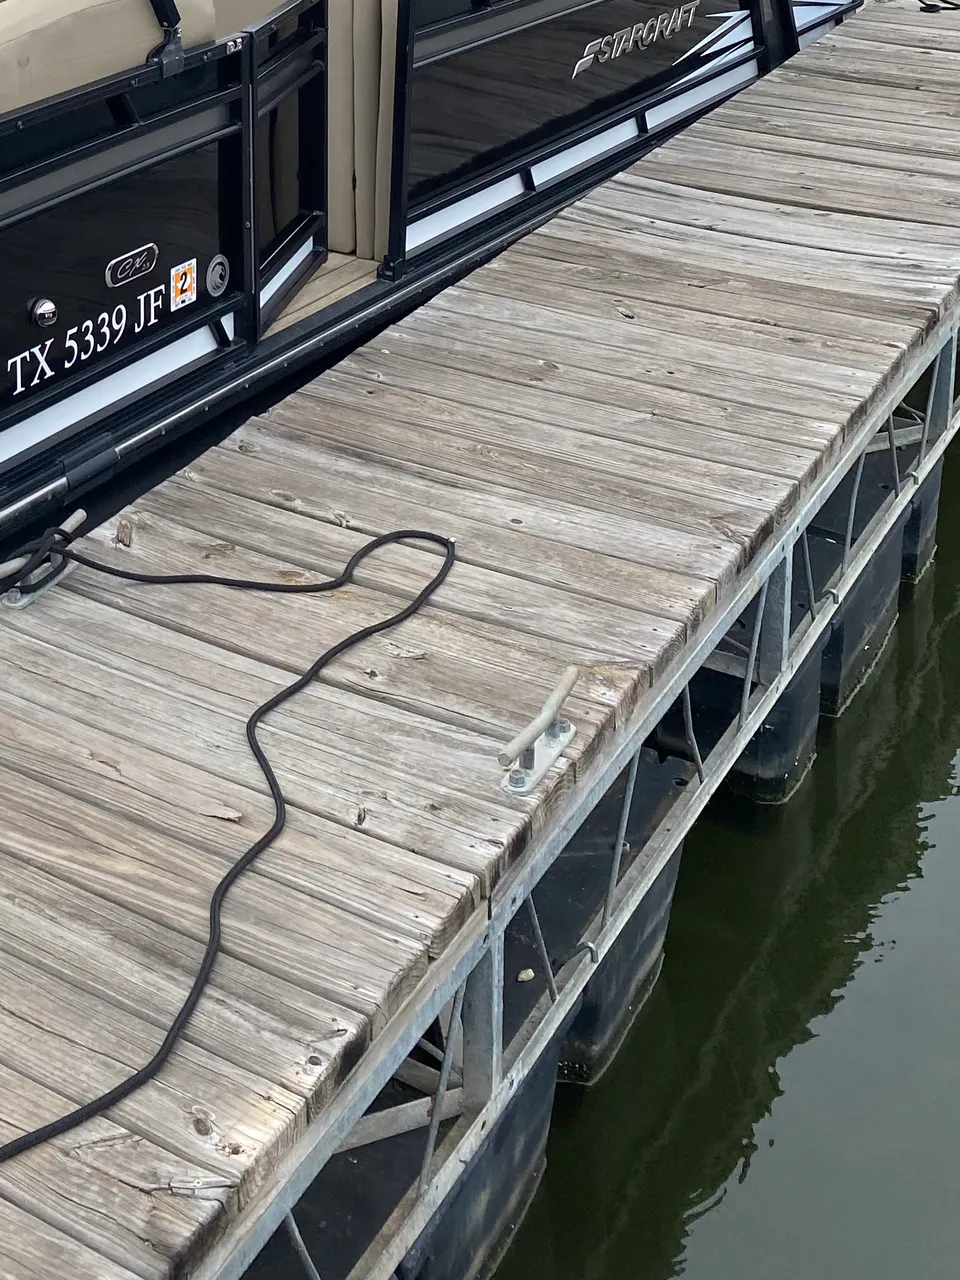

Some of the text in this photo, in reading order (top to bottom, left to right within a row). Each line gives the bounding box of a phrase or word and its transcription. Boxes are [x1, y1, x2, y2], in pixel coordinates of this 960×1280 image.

[596, 0, 701, 64] STARCRAFT
[7, 338, 55, 395] TX
[64, 304, 127, 369] 5339
[134, 284, 166, 334] JF
